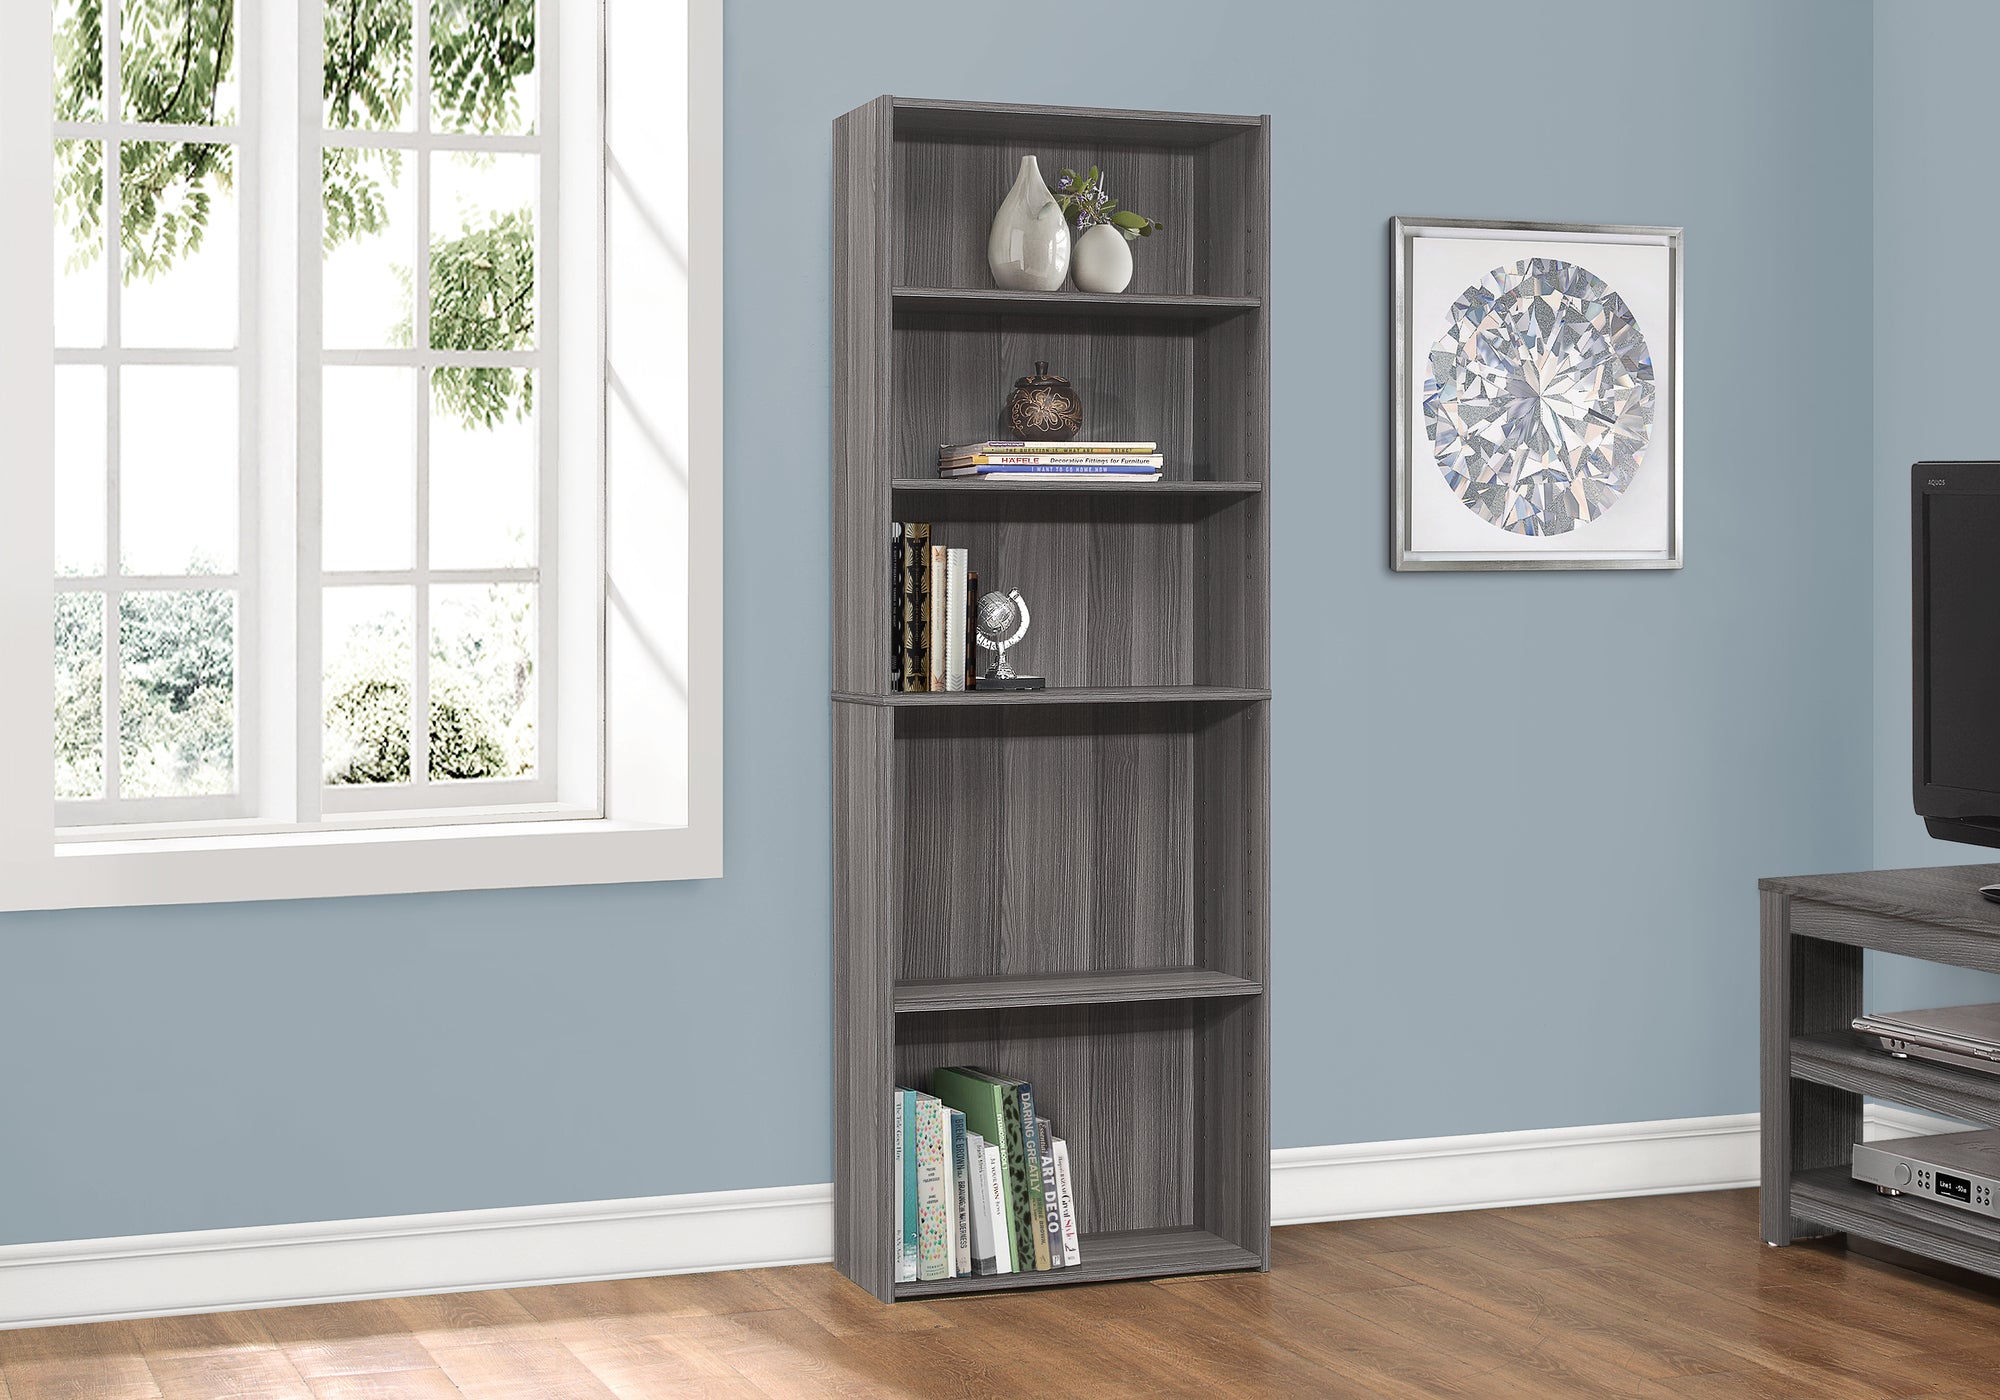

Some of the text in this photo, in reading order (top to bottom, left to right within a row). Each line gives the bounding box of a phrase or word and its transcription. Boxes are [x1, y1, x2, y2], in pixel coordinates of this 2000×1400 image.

[1085, 457, 1109, 465] Fittings
[1121, 457, 1150, 465] Furniture
[1021, 1092, 1035, 1138] DARING
[1026, 1140, 1041, 1192] GREATLY
[1041, 1155, 1055, 1186] ART
[1044, 1190, 1060, 1233] DECO
